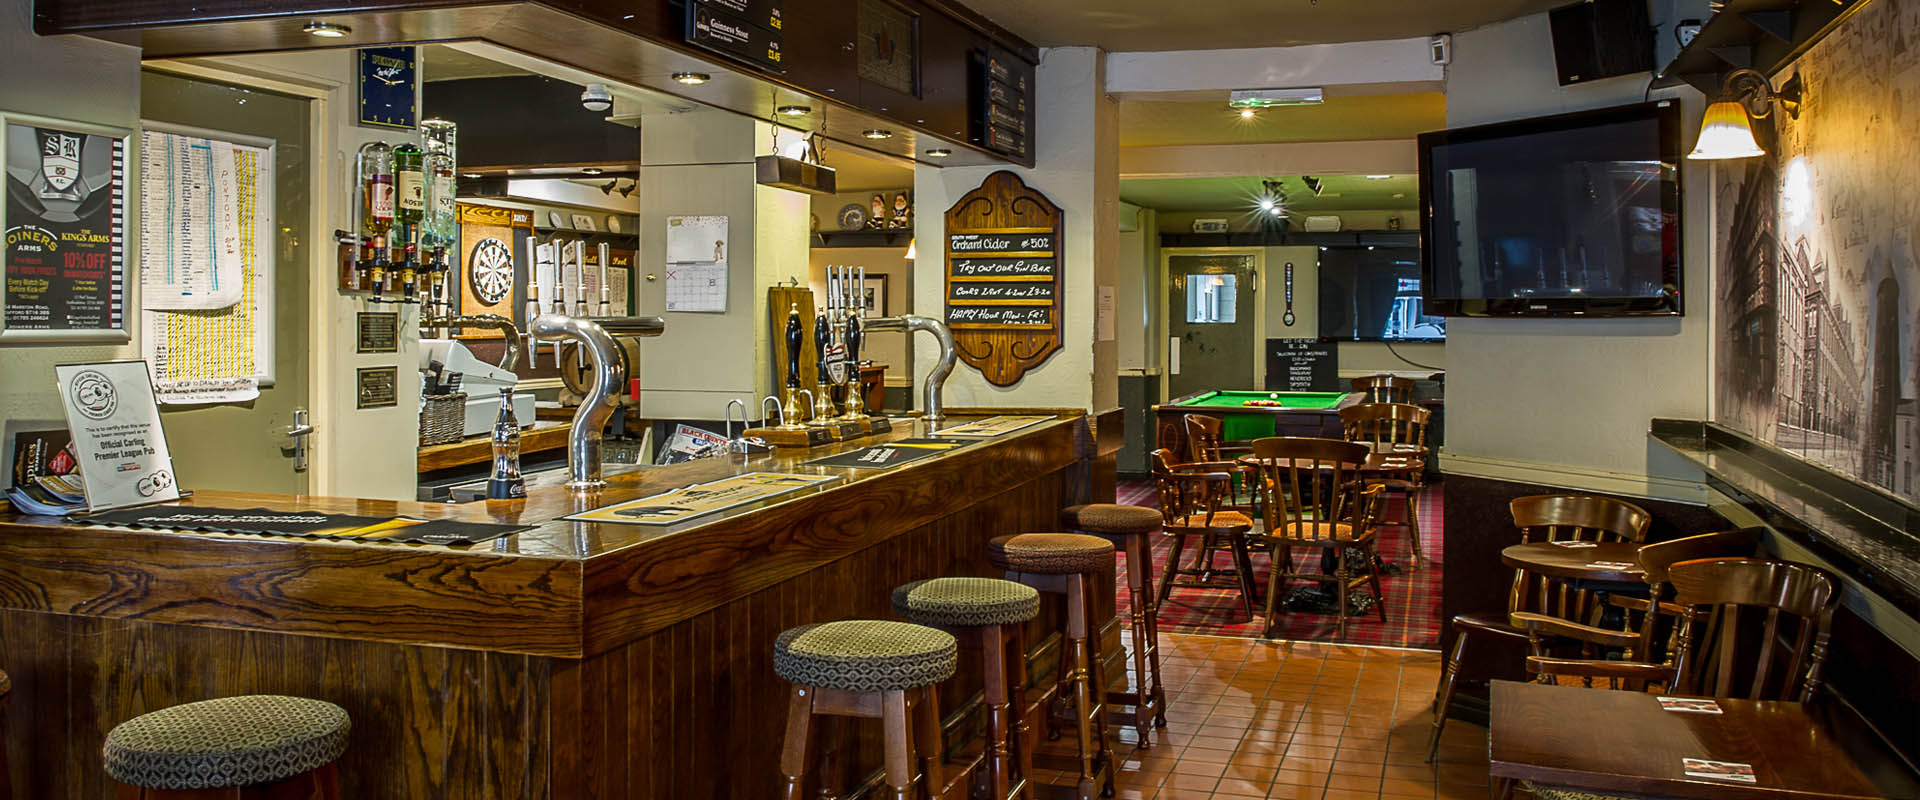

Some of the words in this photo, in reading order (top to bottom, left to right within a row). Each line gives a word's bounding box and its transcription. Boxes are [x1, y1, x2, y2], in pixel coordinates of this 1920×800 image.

[711, 18, 735, 34] Guinness
[735, 26, 749, 39] Stout
[61, 233, 87, 241] KINGS
[88, 234, 110, 243] ARMS
[952, 240, 982, 250] Orchard
[983, 238, 1011, 249] Cider
[86, 253, 107, 269] OFF
[1030, 264, 1051, 273] BAR
[682, 427, 702, 438] BLACK
[100, 439, 122, 449] Official
[123, 438, 146, 448] Carling
[94, 451, 120, 461] Premier
[120, 448, 143, 458] League
[143, 447, 155, 455] Pub
